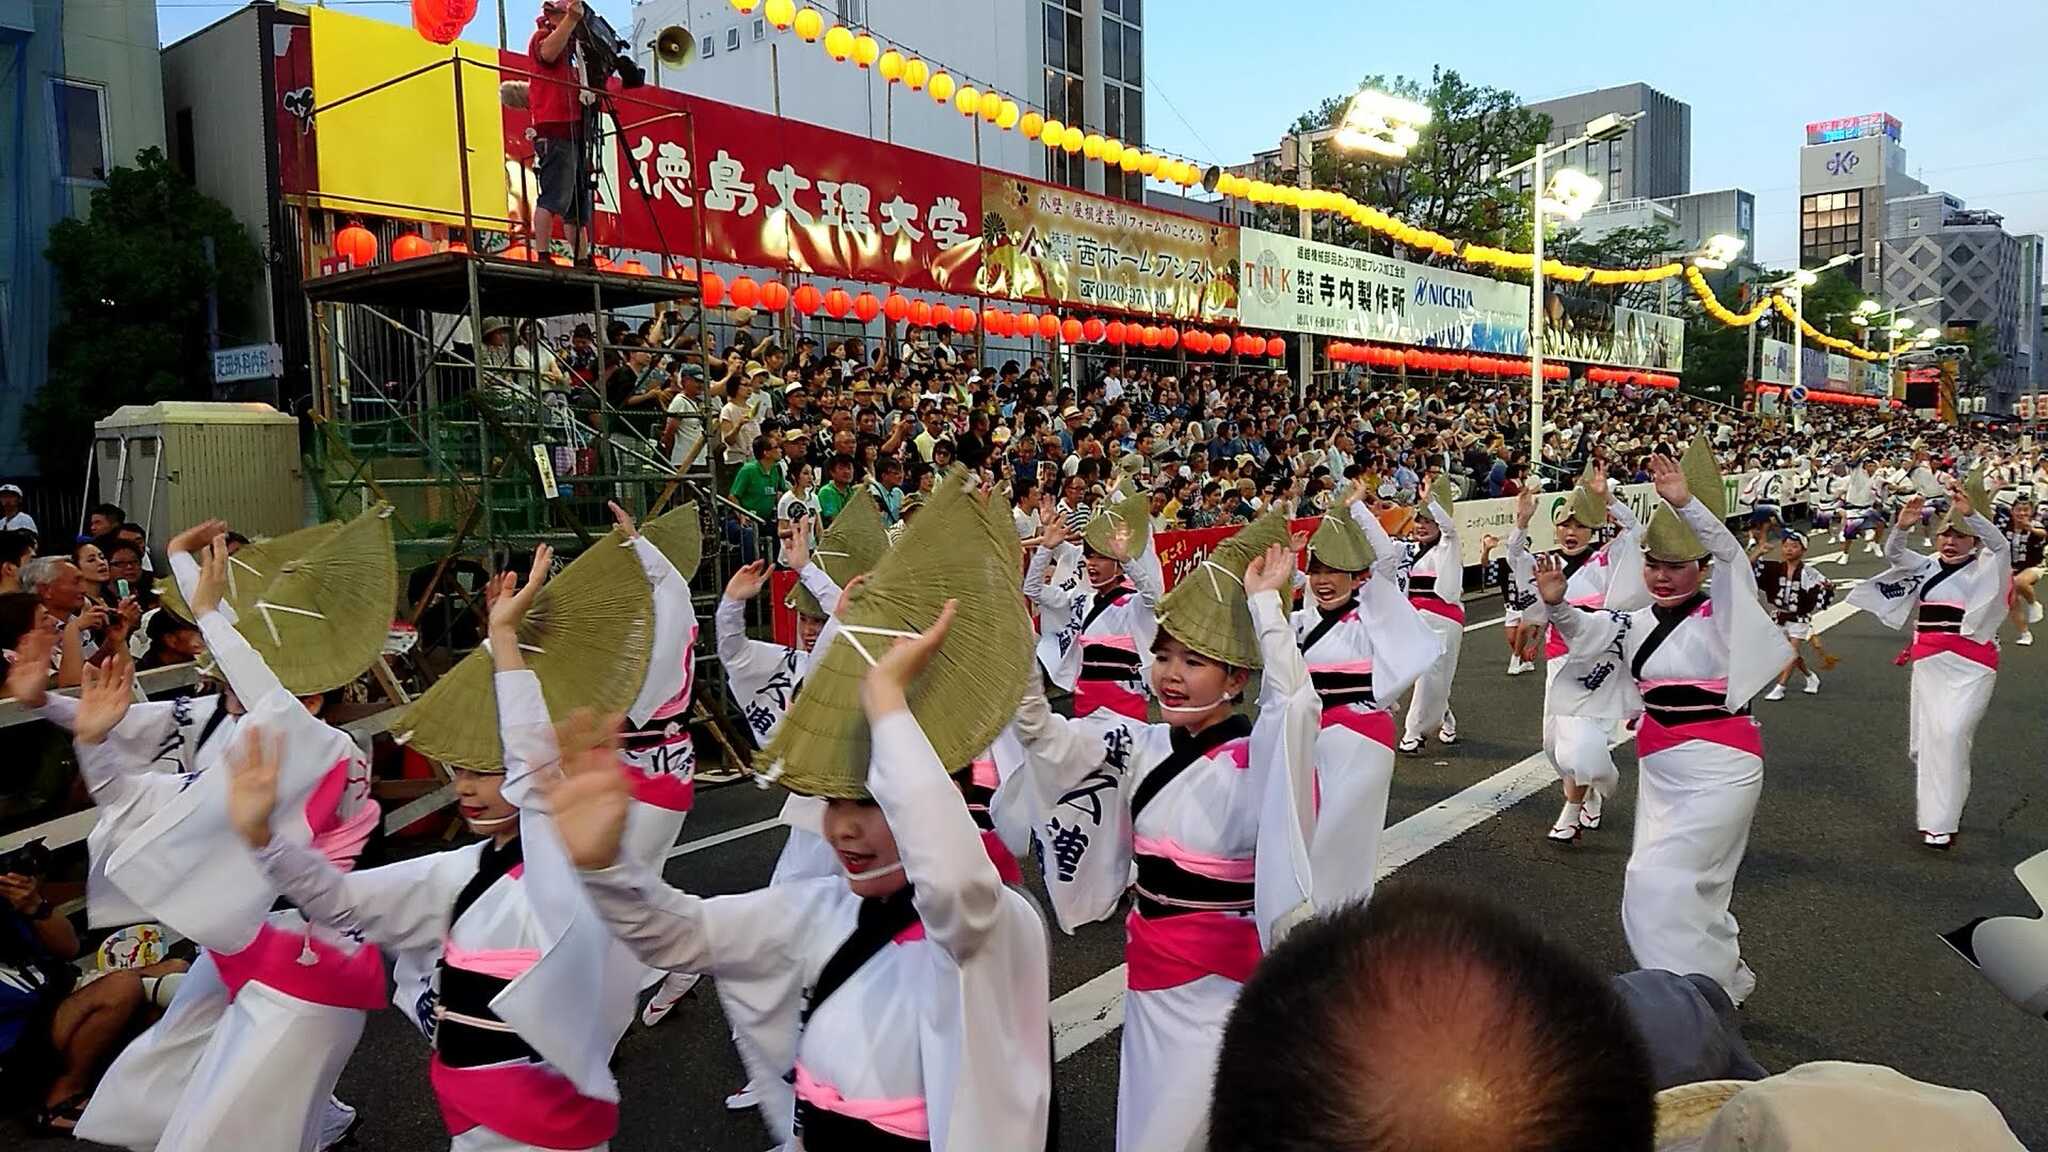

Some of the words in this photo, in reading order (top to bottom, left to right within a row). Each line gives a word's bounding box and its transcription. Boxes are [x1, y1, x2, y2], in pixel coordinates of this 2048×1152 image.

[629, 136, 971, 250] 徳島文理大学
[1076, 236, 1215, 284] 茜ホームアシスト
[1245, 261, 1292, 293] TNK
[1297, 270, 1314, 287] 株式
[1297, 287, 1315, 305] 会社
[1319, 273, 1406, 318] 寺内製作所
[1428, 284, 1474, 309] NICHIA
